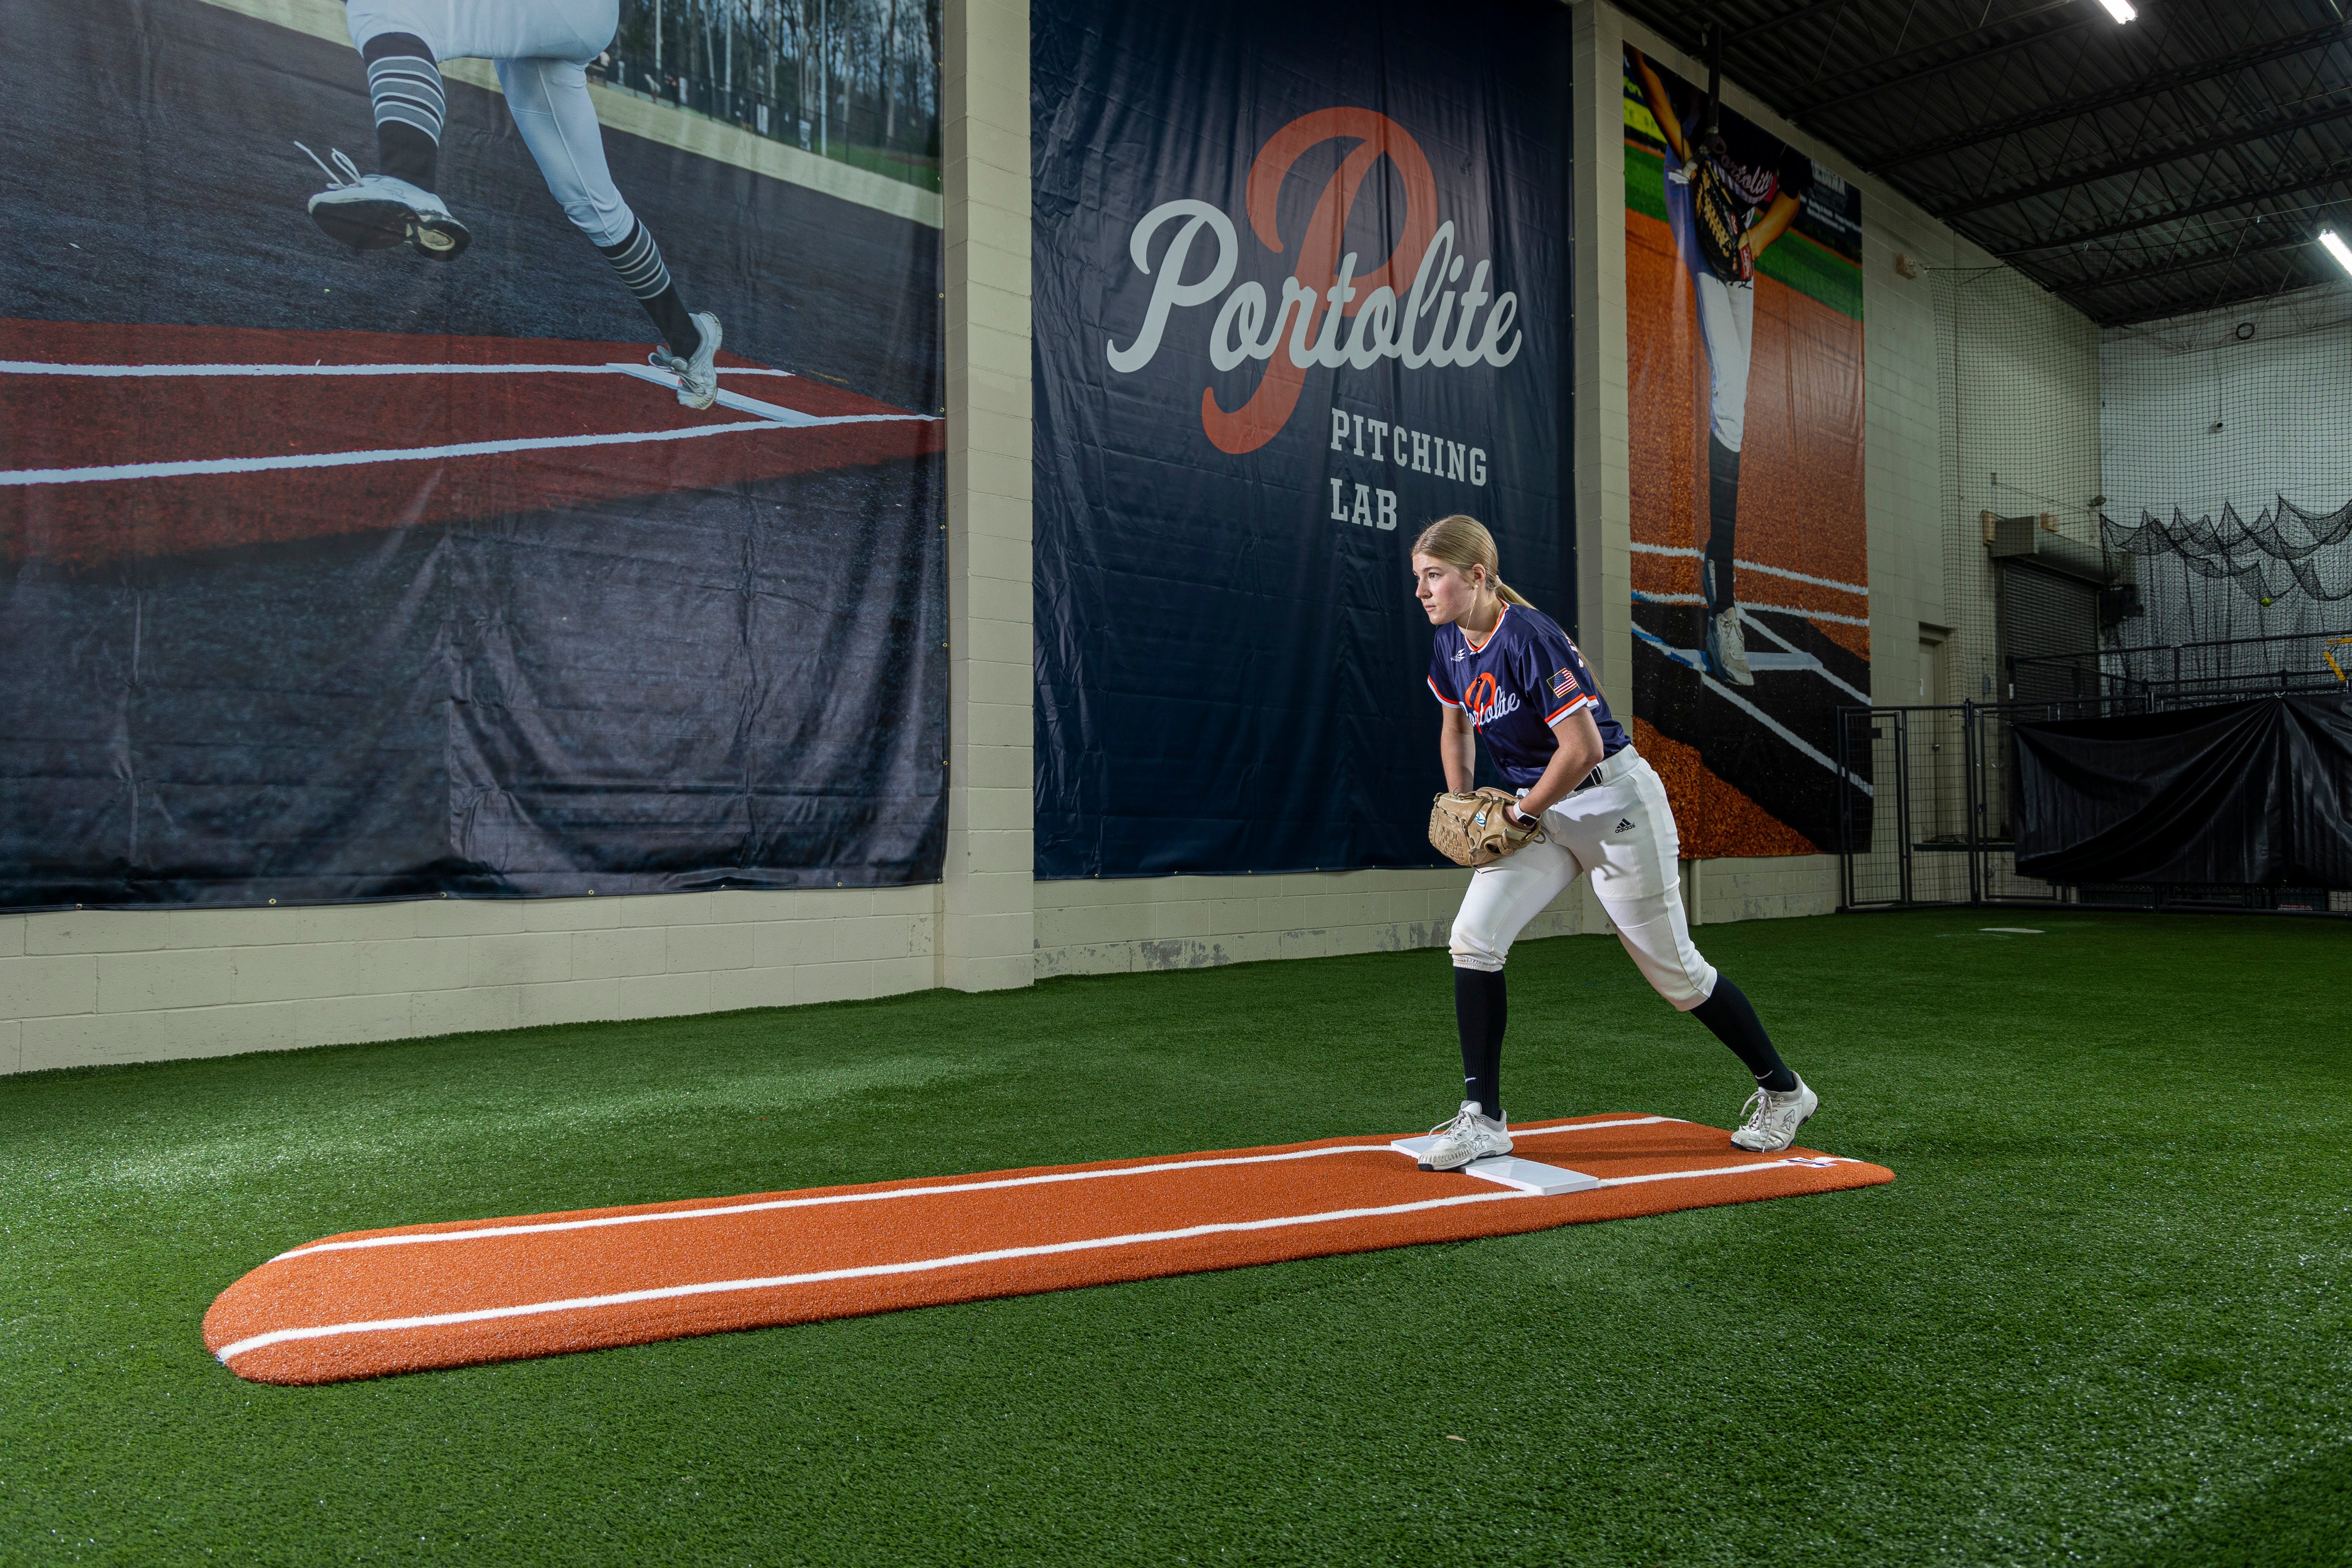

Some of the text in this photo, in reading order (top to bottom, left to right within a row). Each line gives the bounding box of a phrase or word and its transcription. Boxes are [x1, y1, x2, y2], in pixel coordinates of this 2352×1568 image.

[1106, 199, 1522, 373] Portolite
[1331, 407, 1487, 487] PITCHING
[1331, 478, 1397, 531] LAB
[1615, 824, 1635, 833] adidas
